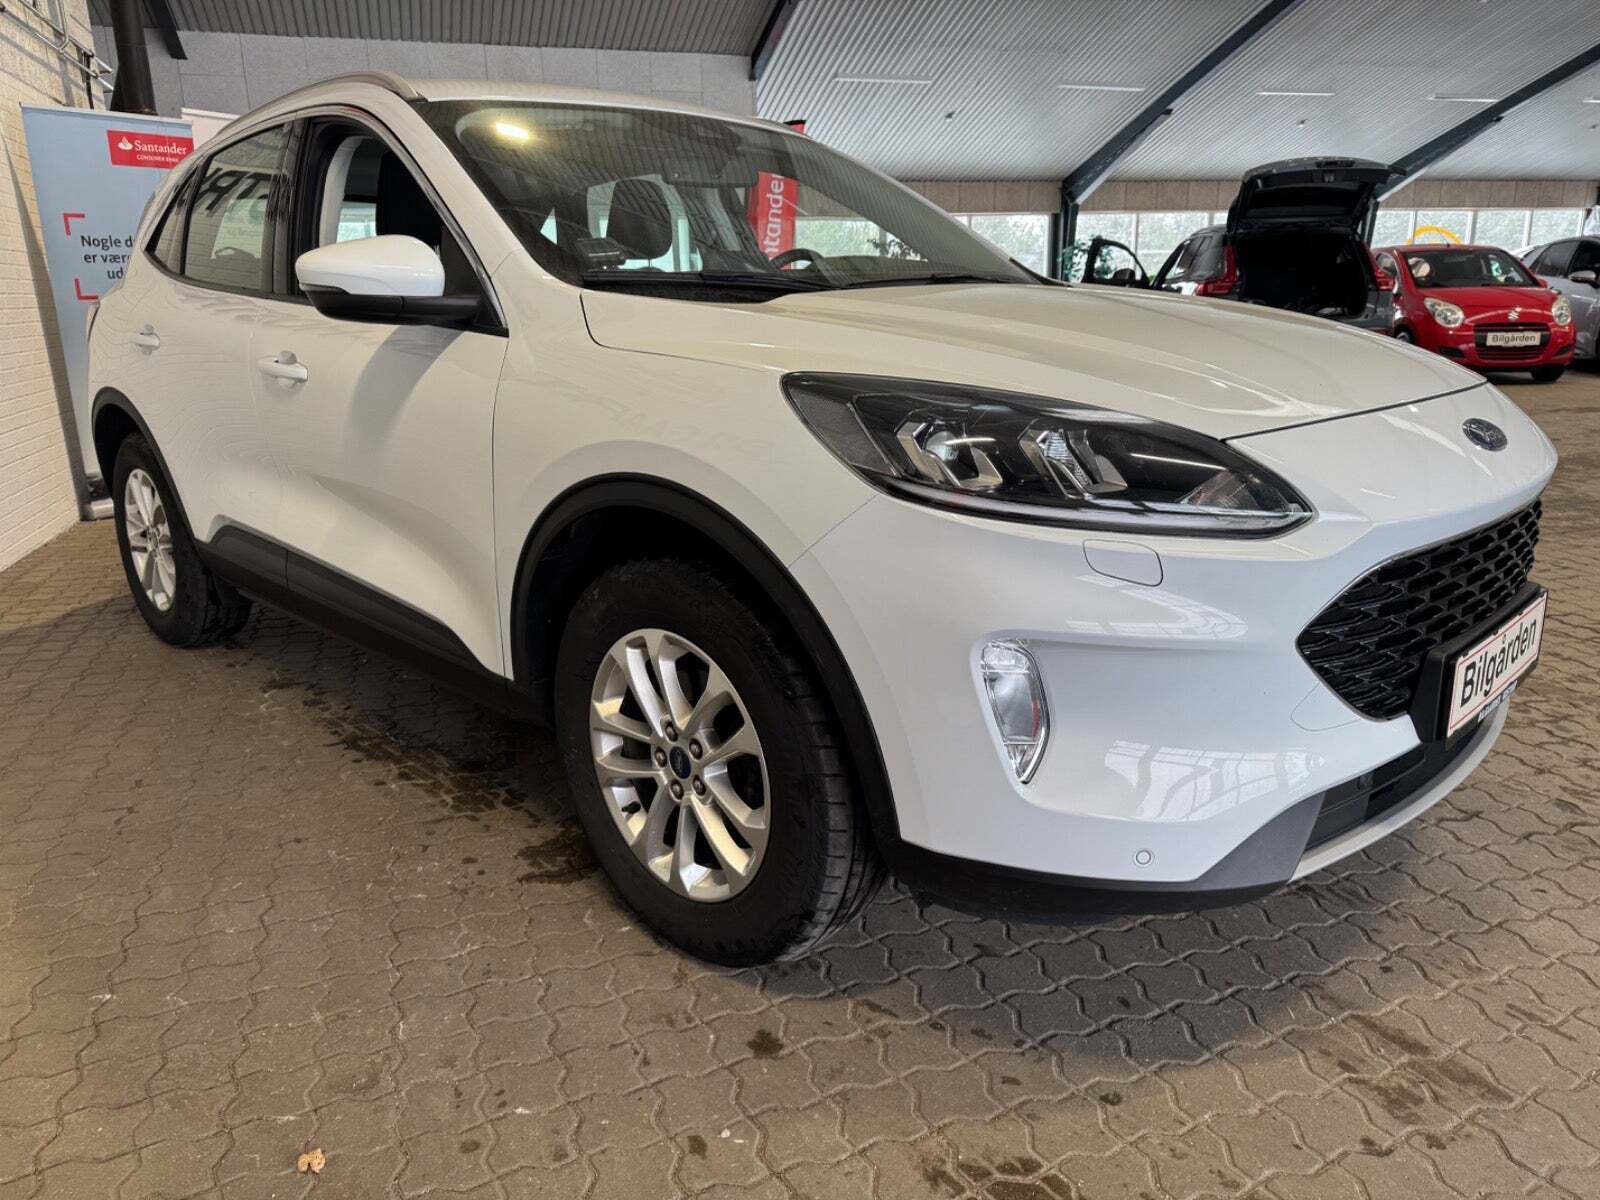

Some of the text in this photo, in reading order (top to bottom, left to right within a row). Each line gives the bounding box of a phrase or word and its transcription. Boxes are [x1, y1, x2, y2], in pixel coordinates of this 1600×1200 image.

[134, 140, 187, 154] Santander
[81, 234, 135, 251] Nogle d
[83, 253, 130, 263] er vær
[107, 266, 124, 279] ud
[1492, 334, 1536, 344] Bilgården
[1460, 619, 1537, 708] Bilgården
